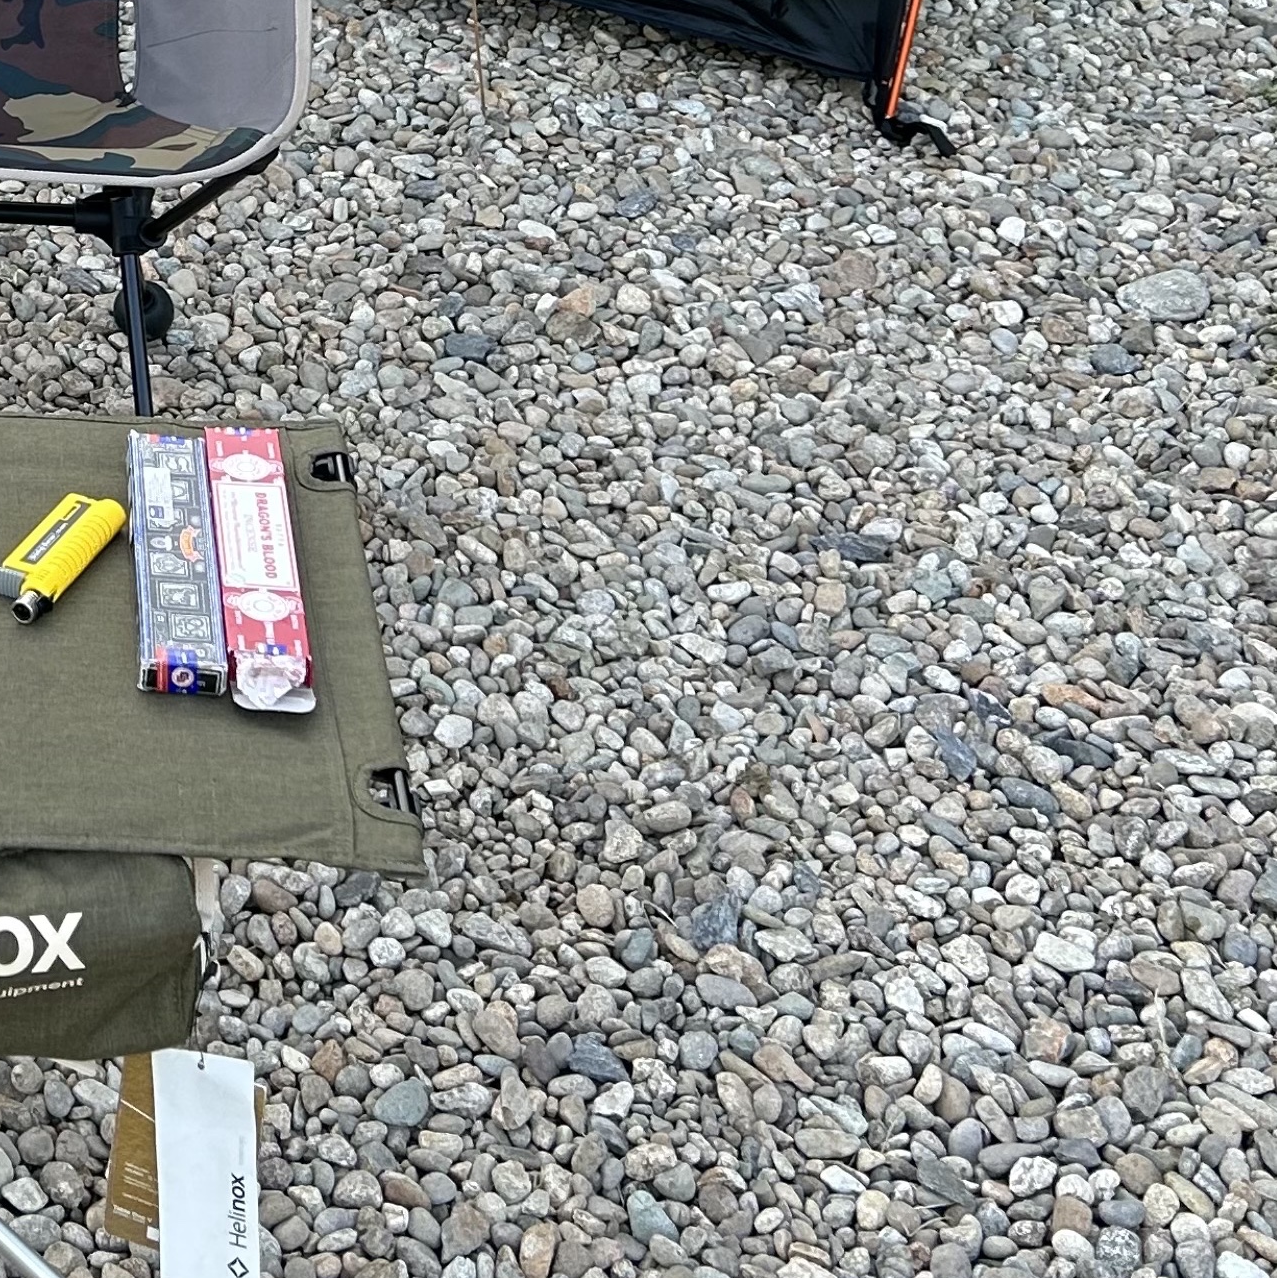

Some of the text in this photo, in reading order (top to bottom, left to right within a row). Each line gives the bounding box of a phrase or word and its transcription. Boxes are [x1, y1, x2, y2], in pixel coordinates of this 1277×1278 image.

[255, 492, 277, 579] DRAGON'S BLOOD
[228, 1173, 247, 1249] Helinox
